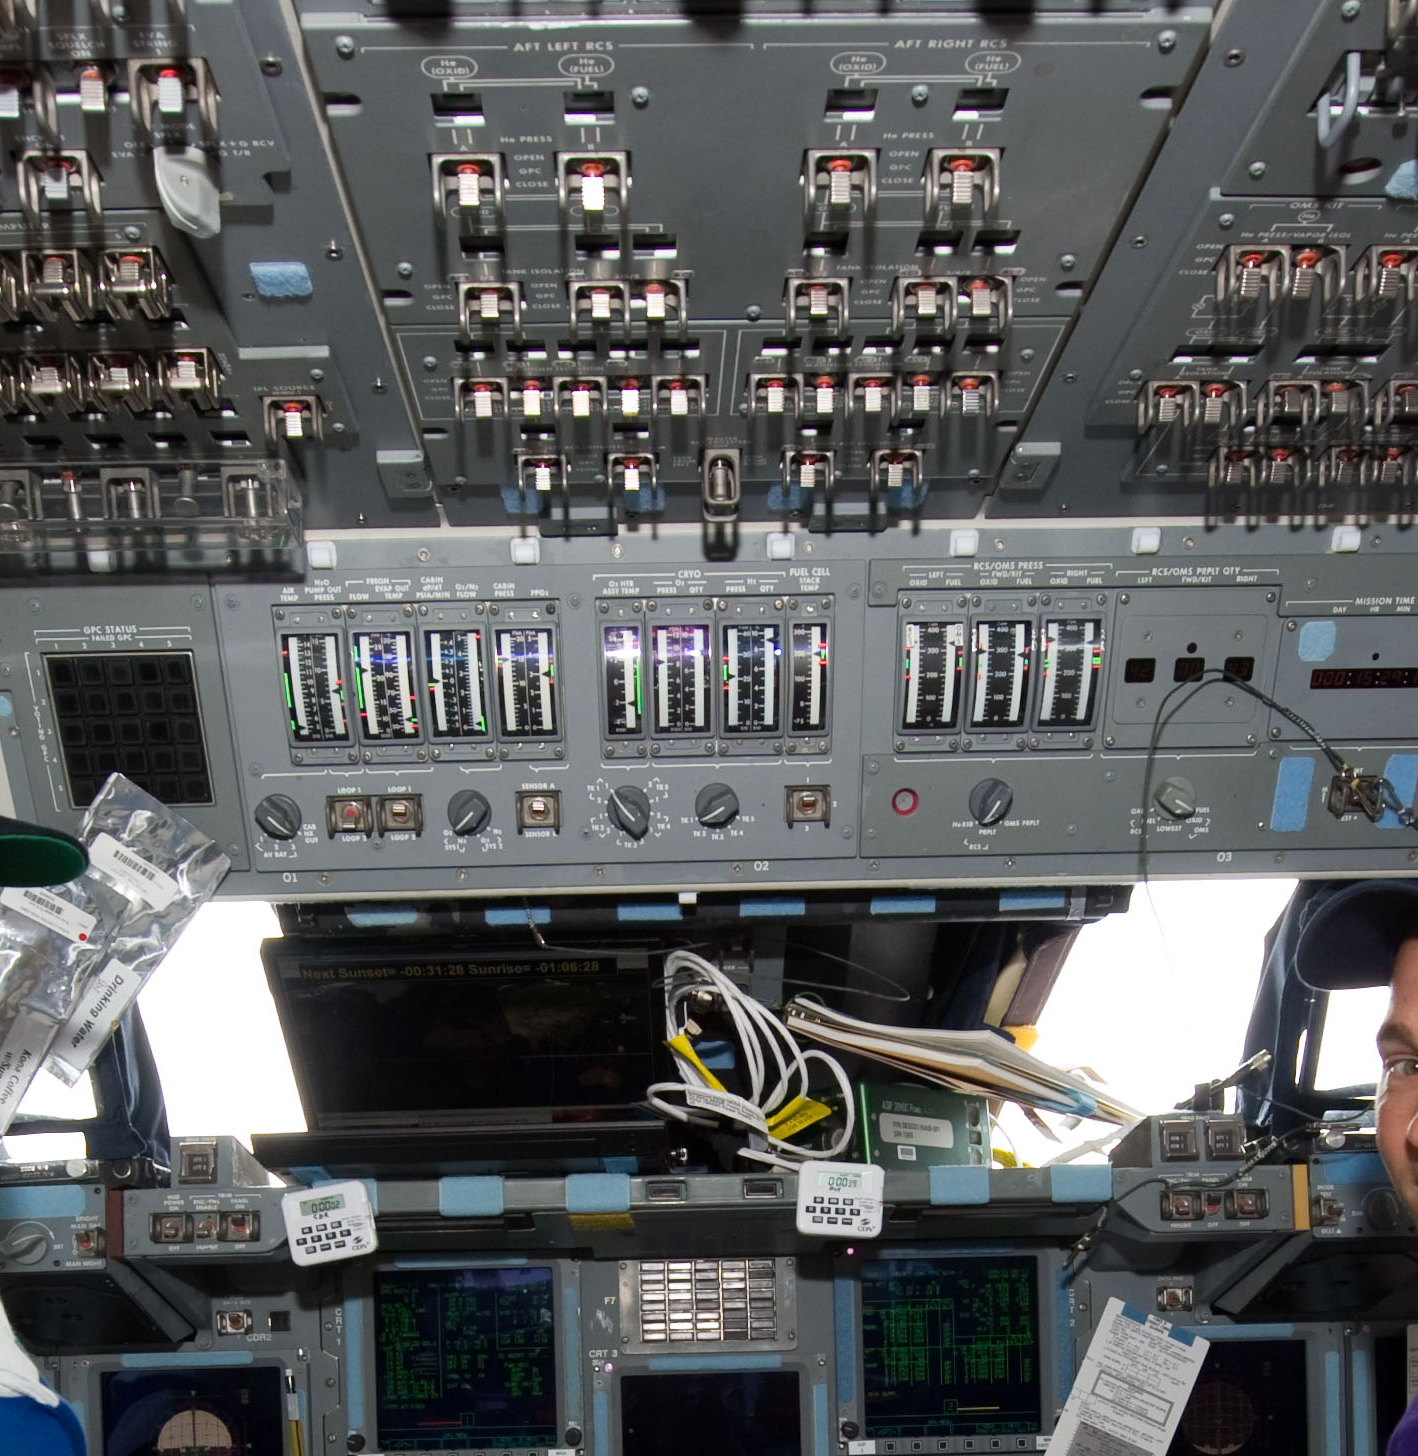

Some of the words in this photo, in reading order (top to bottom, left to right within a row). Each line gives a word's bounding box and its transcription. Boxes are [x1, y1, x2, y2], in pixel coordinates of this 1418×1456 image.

[513, 42, 542, 51] AFT
[547, 41, 579, 51] LEFT
[585, 41, 614, 51] RCS
[894, 39, 923, 49] AFT
[928, 39, 974, 48] RIGHT
[979, 39, 1008, 48] RCS
[515, 180, 549, 188] CLOSE
[1289, 201, 1323, 210] OMS
[1324, 201, 1345, 210] KIT
[973, 561, 1015, 570] RCS/OMS
[1018, 561, 1043, 570] PRESS
[677, 569, 702, 579] CRYO
[789, 568, 810, 577] FUEL
[812, 568, 831, 576] CELL
[928, 570, 944, 578] LEFT
[992, 570, 1022, 578] FWD/KIT
[1066, 569, 1088, 577] RIGHT
[1152, 567, 1193, 577] RCS/OMS
[1196, 567, 1220, 576] PRPLT
[1222, 566, 1241, 575] QTY
[1086, 577, 1103, 585] FUEL
[1137, 576, 1153, 584] LEFT
[1236, 575, 1258, 583] RIGHT
[689, 586, 704, 594] QTY
[726, 585, 746, 593] PRESS
[800, 584, 819, 592] TEMP
[349, 593, 370, 601] FLOW
[416, 590, 451, 599] PSIA/MIN
[456, 590, 477, 598] FLOW
[494, 589, 515, 597] PRESS
[1355, 597, 1394, 605] MISSION
[1395, 596, 1416, 605] TIME
[1396, 605, 1411, 613] MIN
[83, 625, 104, 635] GPC
[105, 625, 137, 634] STATUS
[91, 634, 111, 642] FAILED
[112, 633, 133, 642] GPC
[90, 973, 125, 1018] Drinking
[71, 1017, 95, 1049] Water
[15, 1048, 32, 1075] Kona
[0, 1073, 20, 1105] Coffee
[603, 1296, 616, 1305] F7
[335, 1308, 343, 1335] CRT
[588, 1350, 608, 1358] CRT
